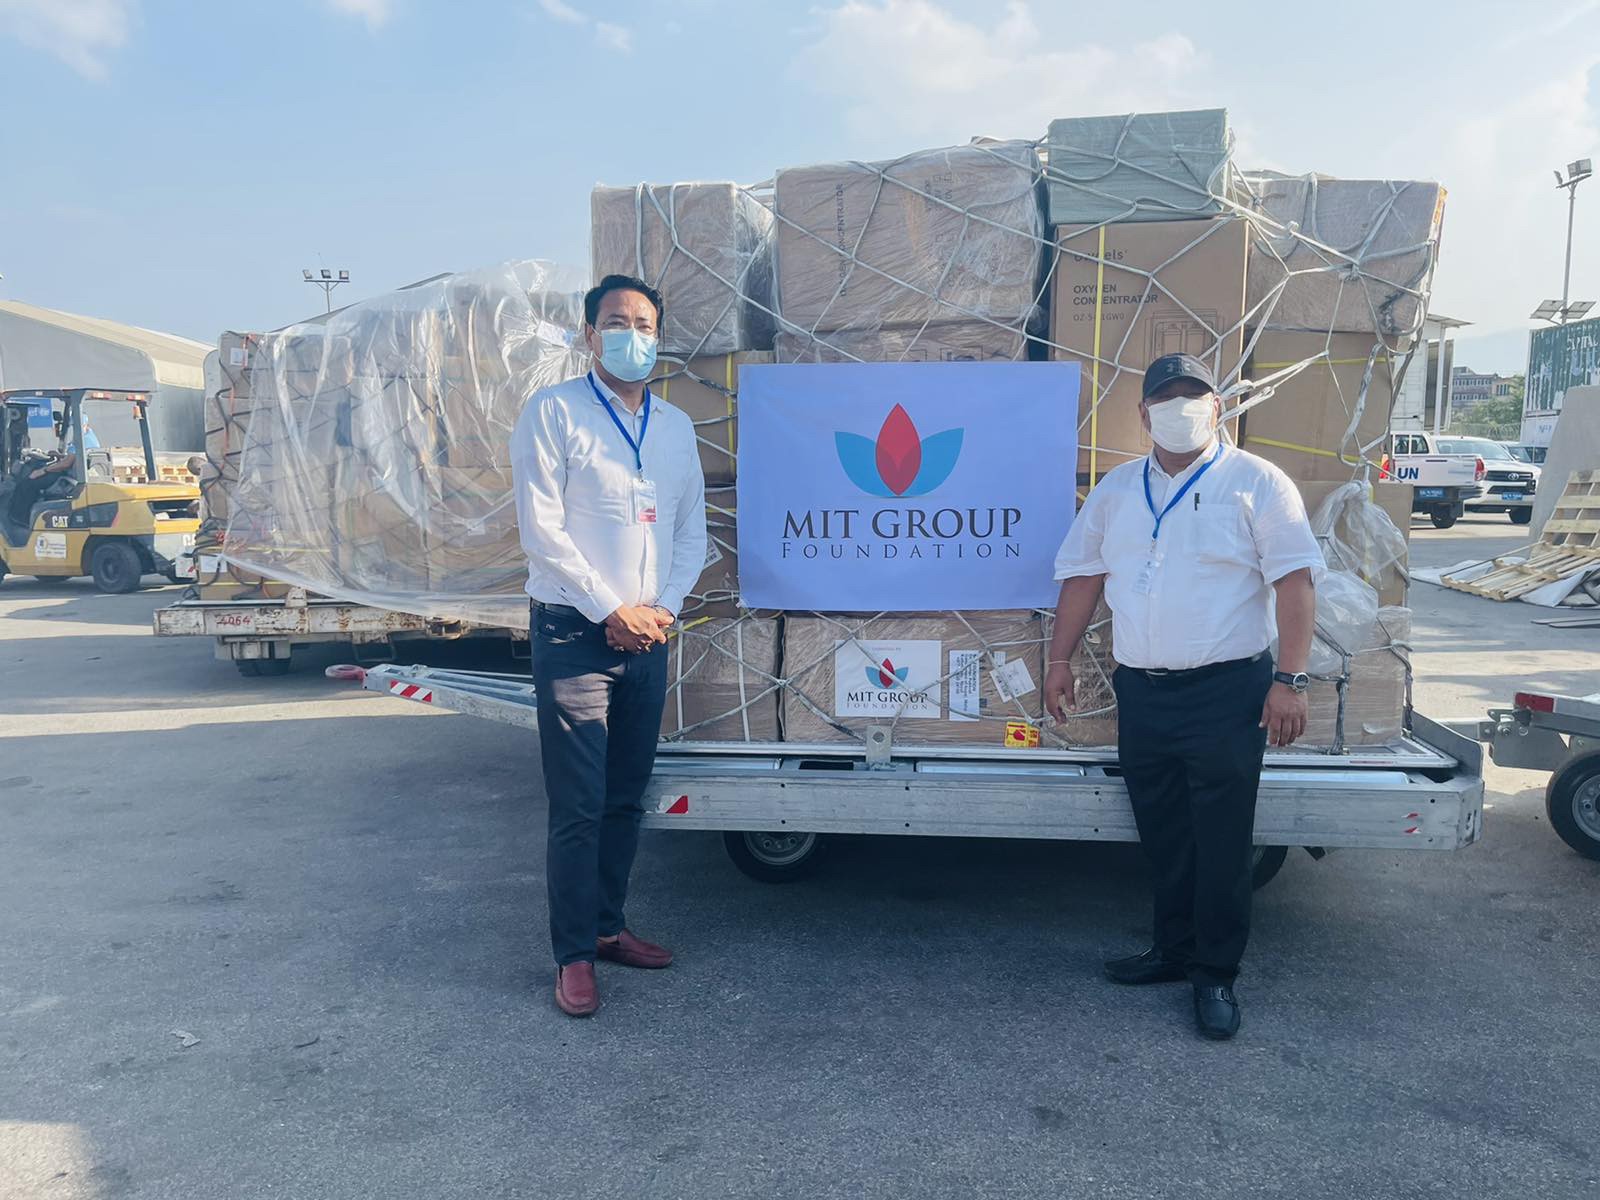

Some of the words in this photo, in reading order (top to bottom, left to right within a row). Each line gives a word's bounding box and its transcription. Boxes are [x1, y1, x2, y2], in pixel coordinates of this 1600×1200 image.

[1073, 284, 1117, 294] OXYEN
[1073, 295, 1158, 305] CONENTRATOR
[1398, 468, 1419, 479] UN
[52, 516, 69, 528] CAT
[782, 509, 859, 539] MIT
[871, 508, 1022, 539] GROUP
[782, 542, 1021, 559] FOUNDATION
[847, 692, 874, 702] MIT
